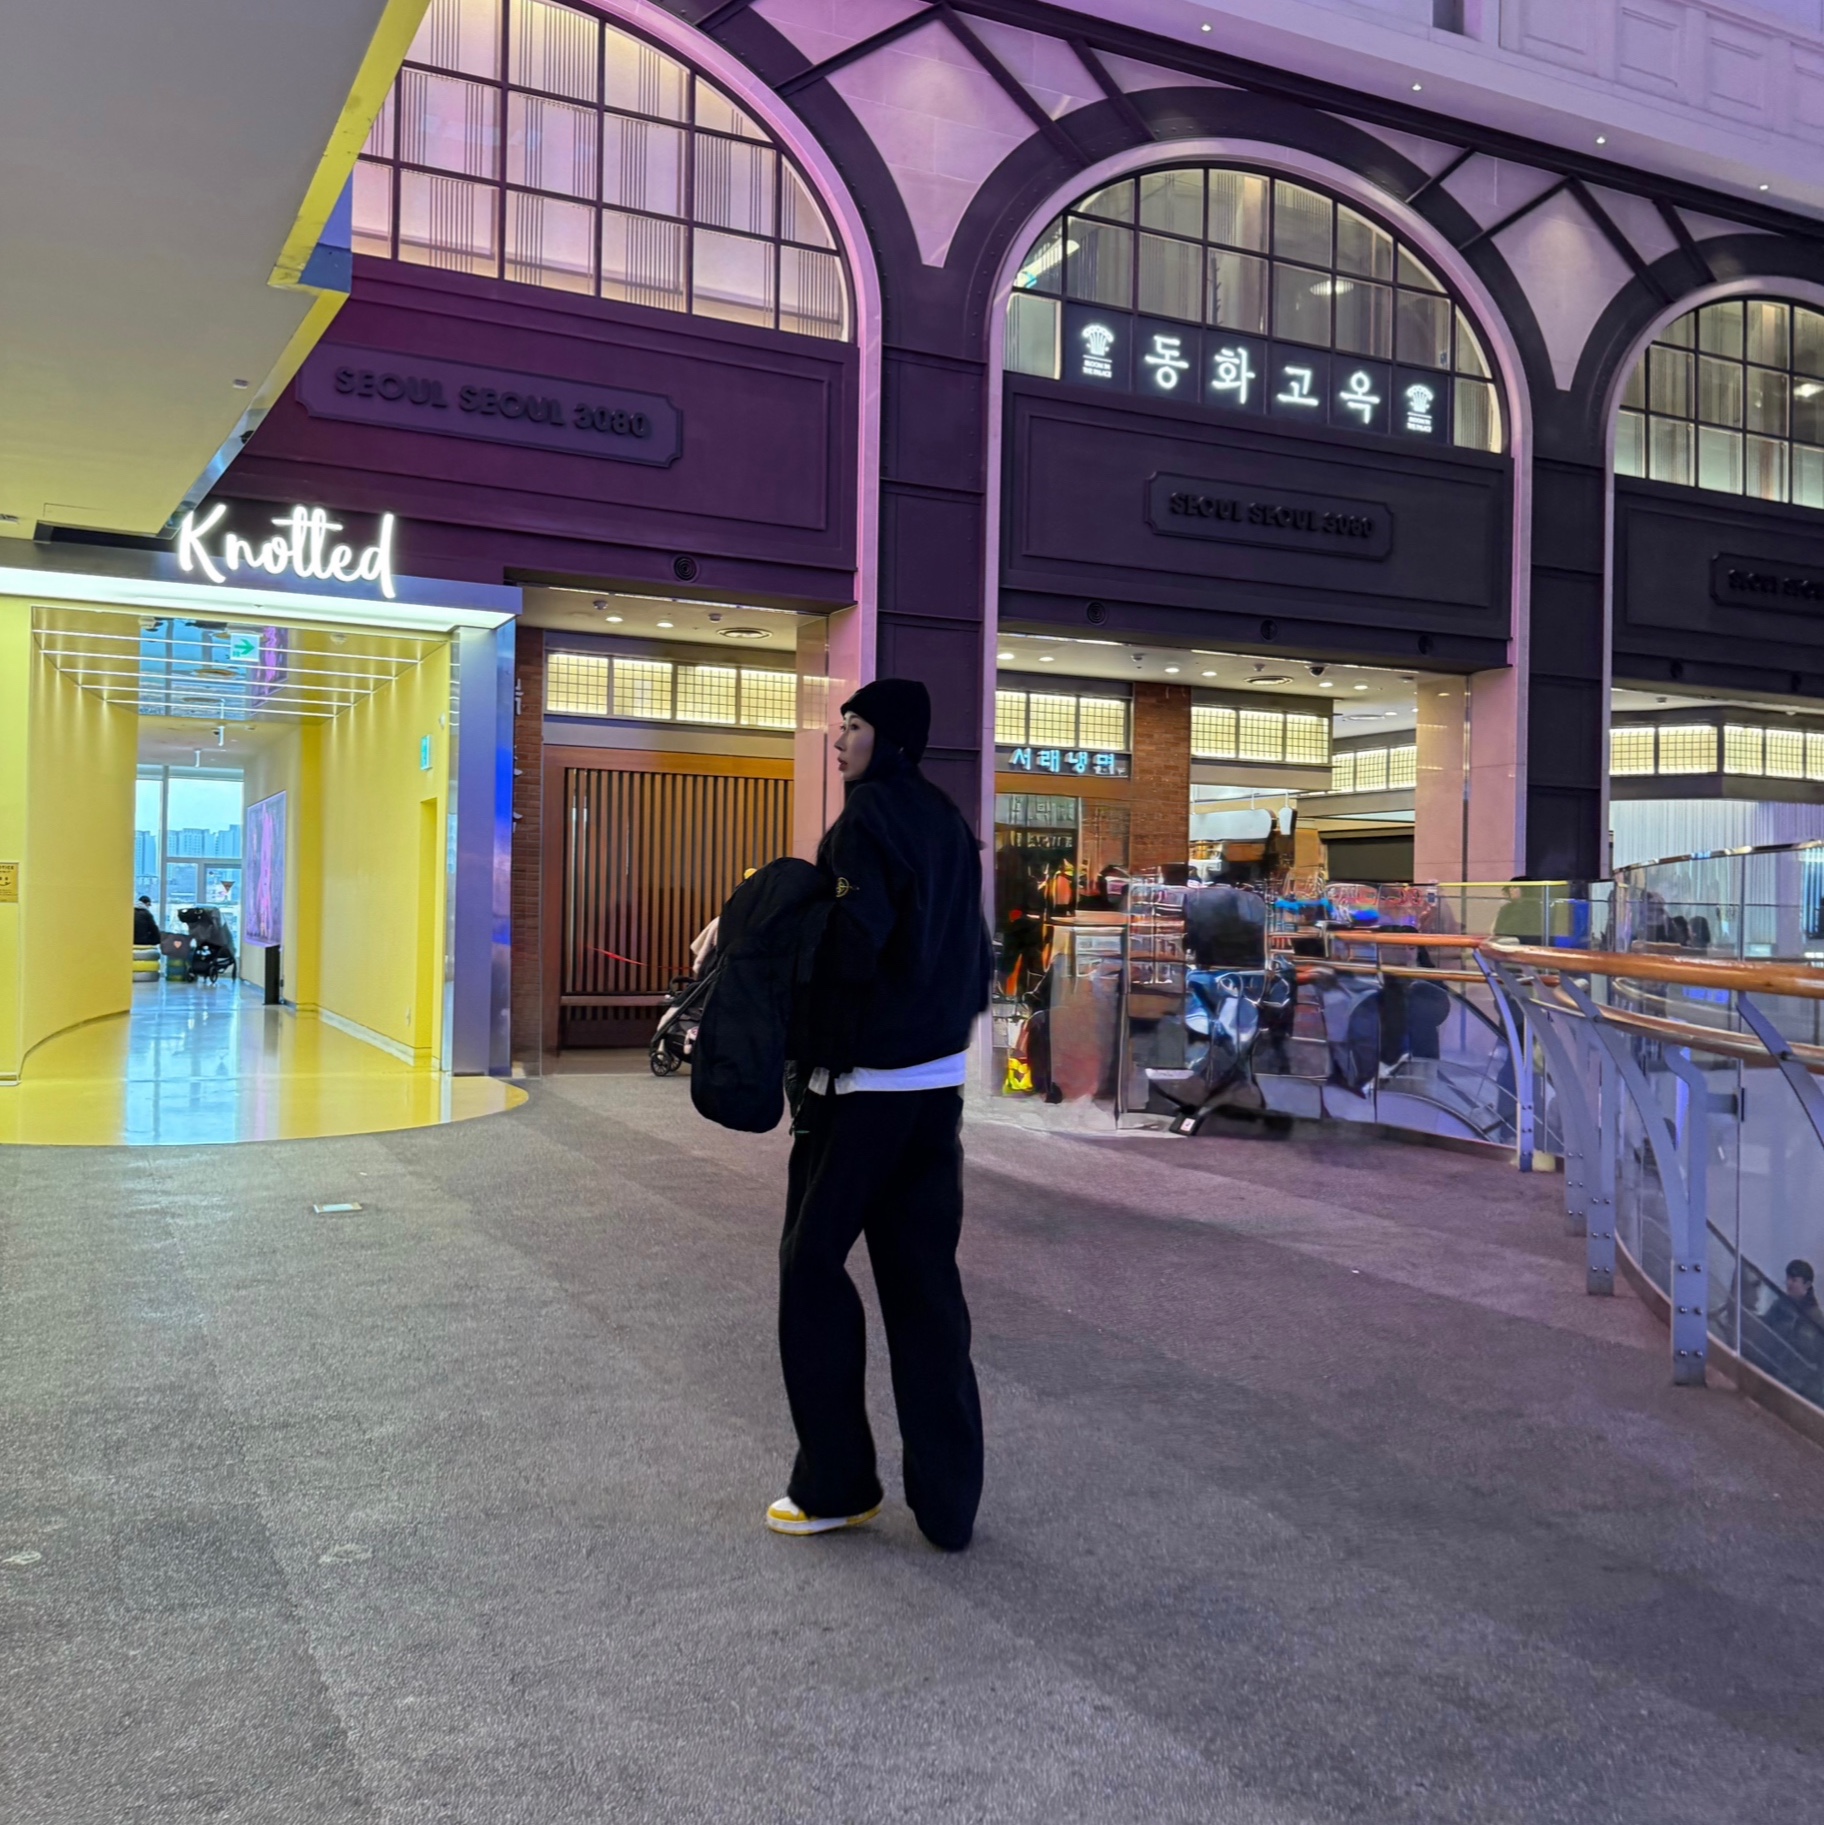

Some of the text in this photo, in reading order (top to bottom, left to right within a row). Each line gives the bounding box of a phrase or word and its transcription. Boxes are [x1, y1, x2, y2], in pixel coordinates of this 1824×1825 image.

[335, 365, 651, 438] SEOUL SEOUL 3080
[1144, 333, 1381, 425] 동화고옥
[177, 503, 397, 599] Knotted
[1170, 492, 1242, 522] SEOUL
[1249, 502, 1319, 532] SEOUL
